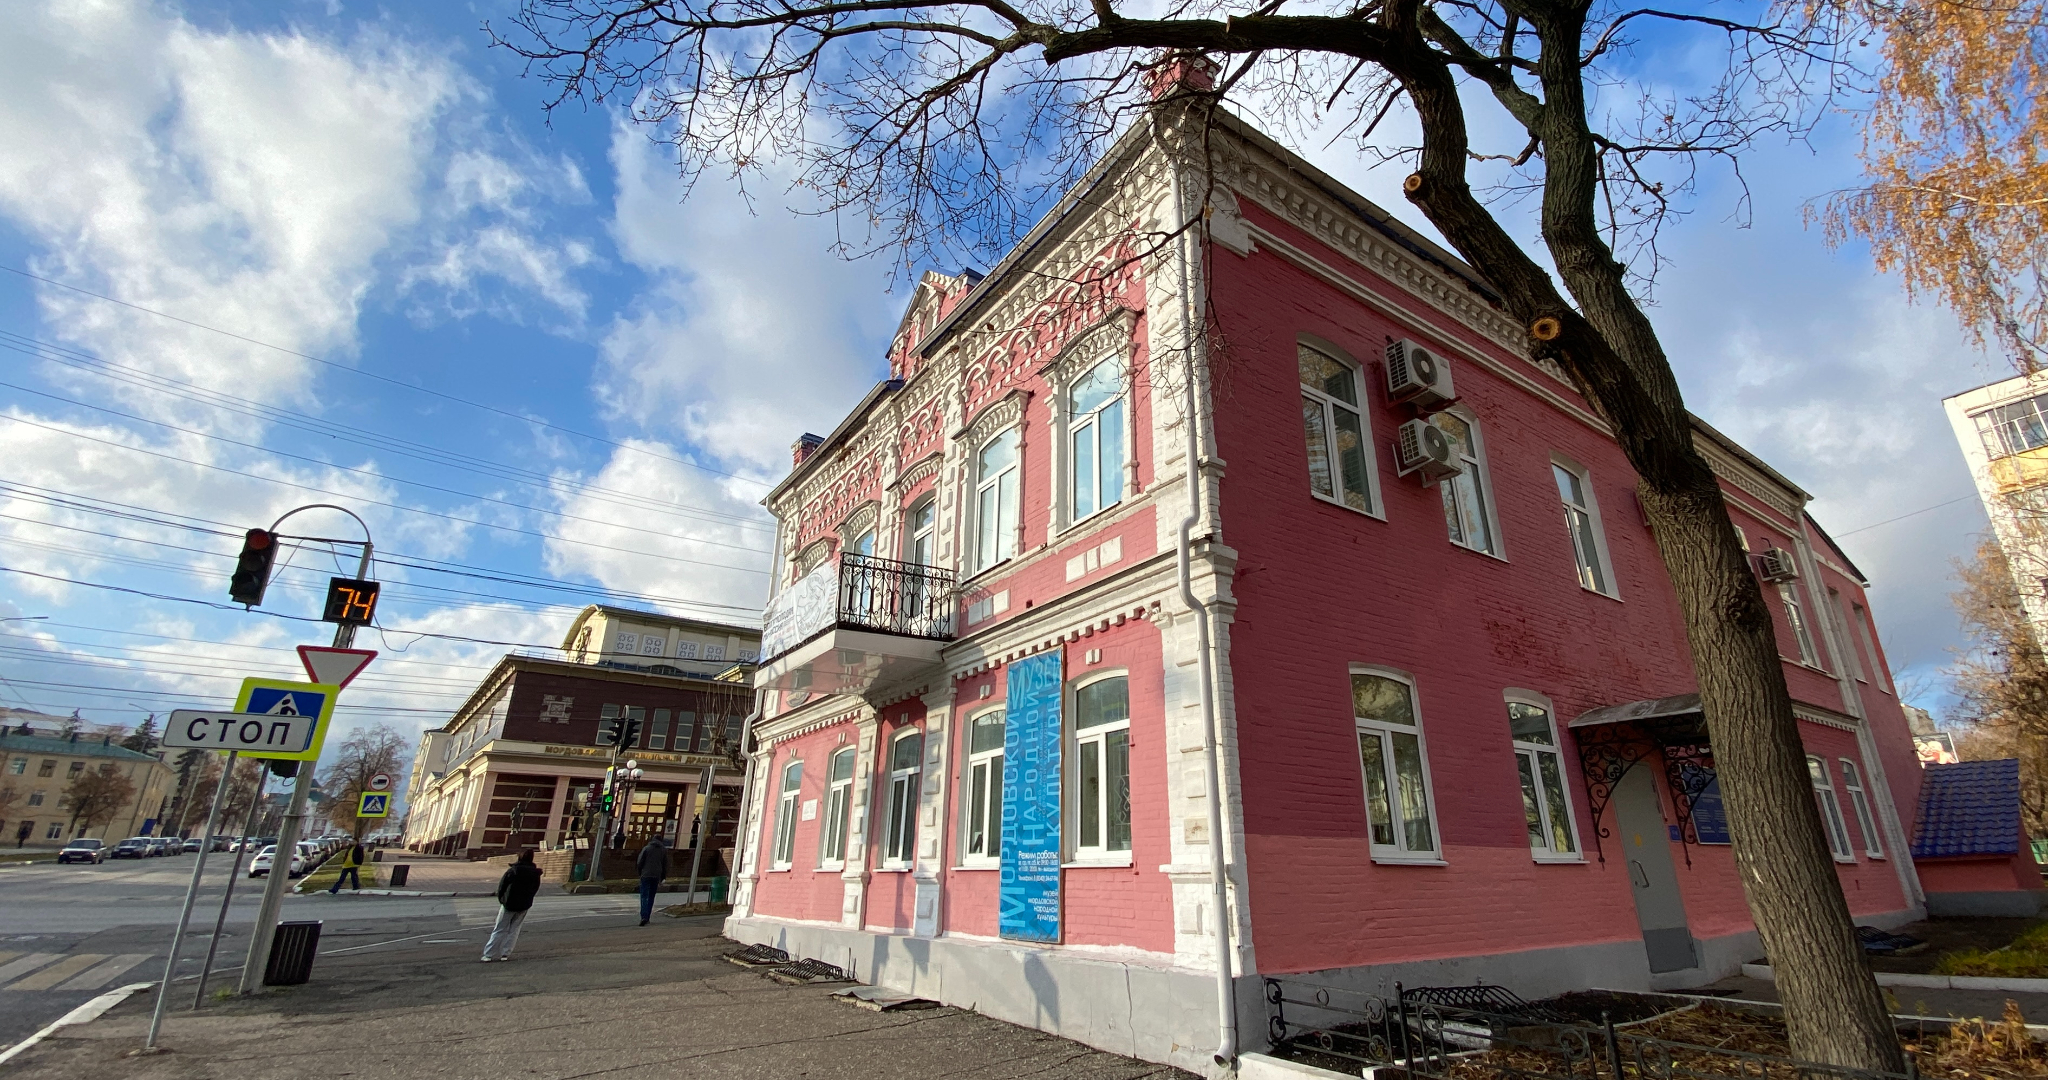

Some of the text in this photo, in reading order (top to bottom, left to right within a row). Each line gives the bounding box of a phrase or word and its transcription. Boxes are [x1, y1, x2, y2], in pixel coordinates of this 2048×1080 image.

[337, 587, 376, 620] 74
[1007, 657, 1061, 711] МУЗЕЙ
[186, 717, 291, 746] СТОП
[611, 749, 682, 763] ЦИОНАЛЬНЫЙ
[1022, 691, 1045, 846] НАРОДНОЙ
[1046, 691, 1061, 837] КУЛЬТУРЫ
[1018, 850, 1036, 859] Режим
[1033, 905, 1058, 913] народной
[1037, 913, 1058, 922] культуры
